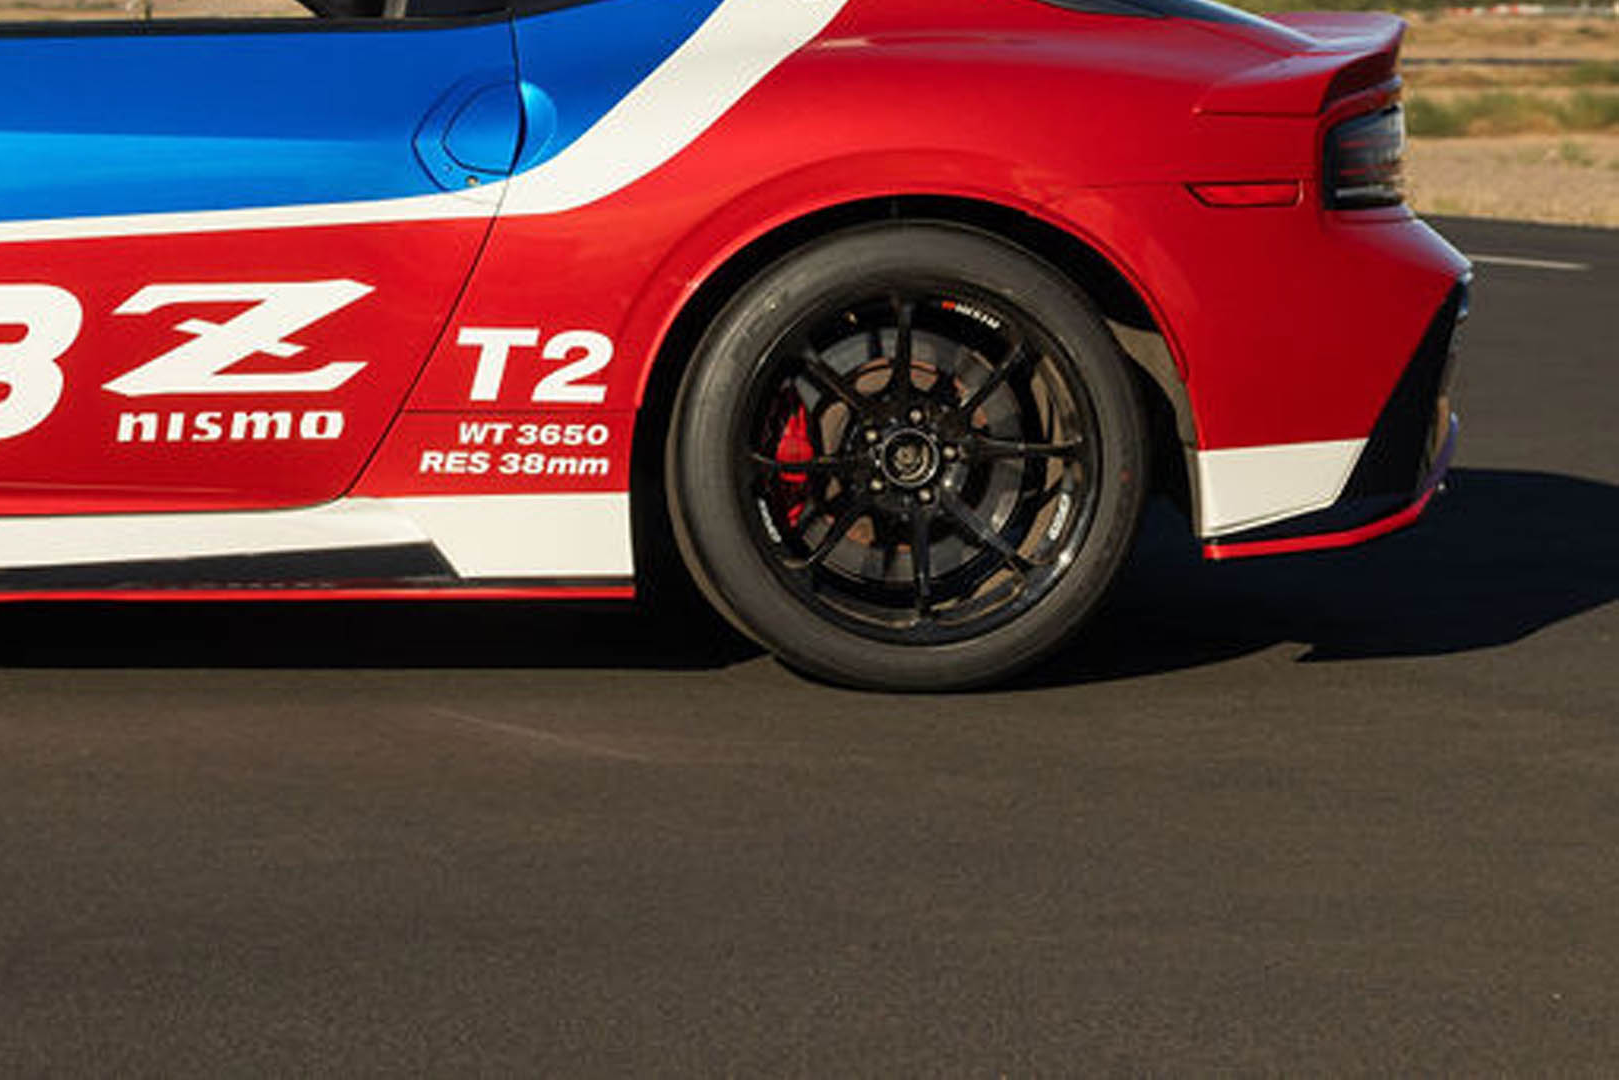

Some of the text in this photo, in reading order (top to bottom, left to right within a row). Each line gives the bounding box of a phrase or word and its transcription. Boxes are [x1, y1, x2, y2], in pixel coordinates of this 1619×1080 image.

[101, 279, 376, 397] Z
[456, 328, 615, 404] T2
[459, 422, 609, 446] WT 3650
[419, 451, 609, 476] RES 38mm
